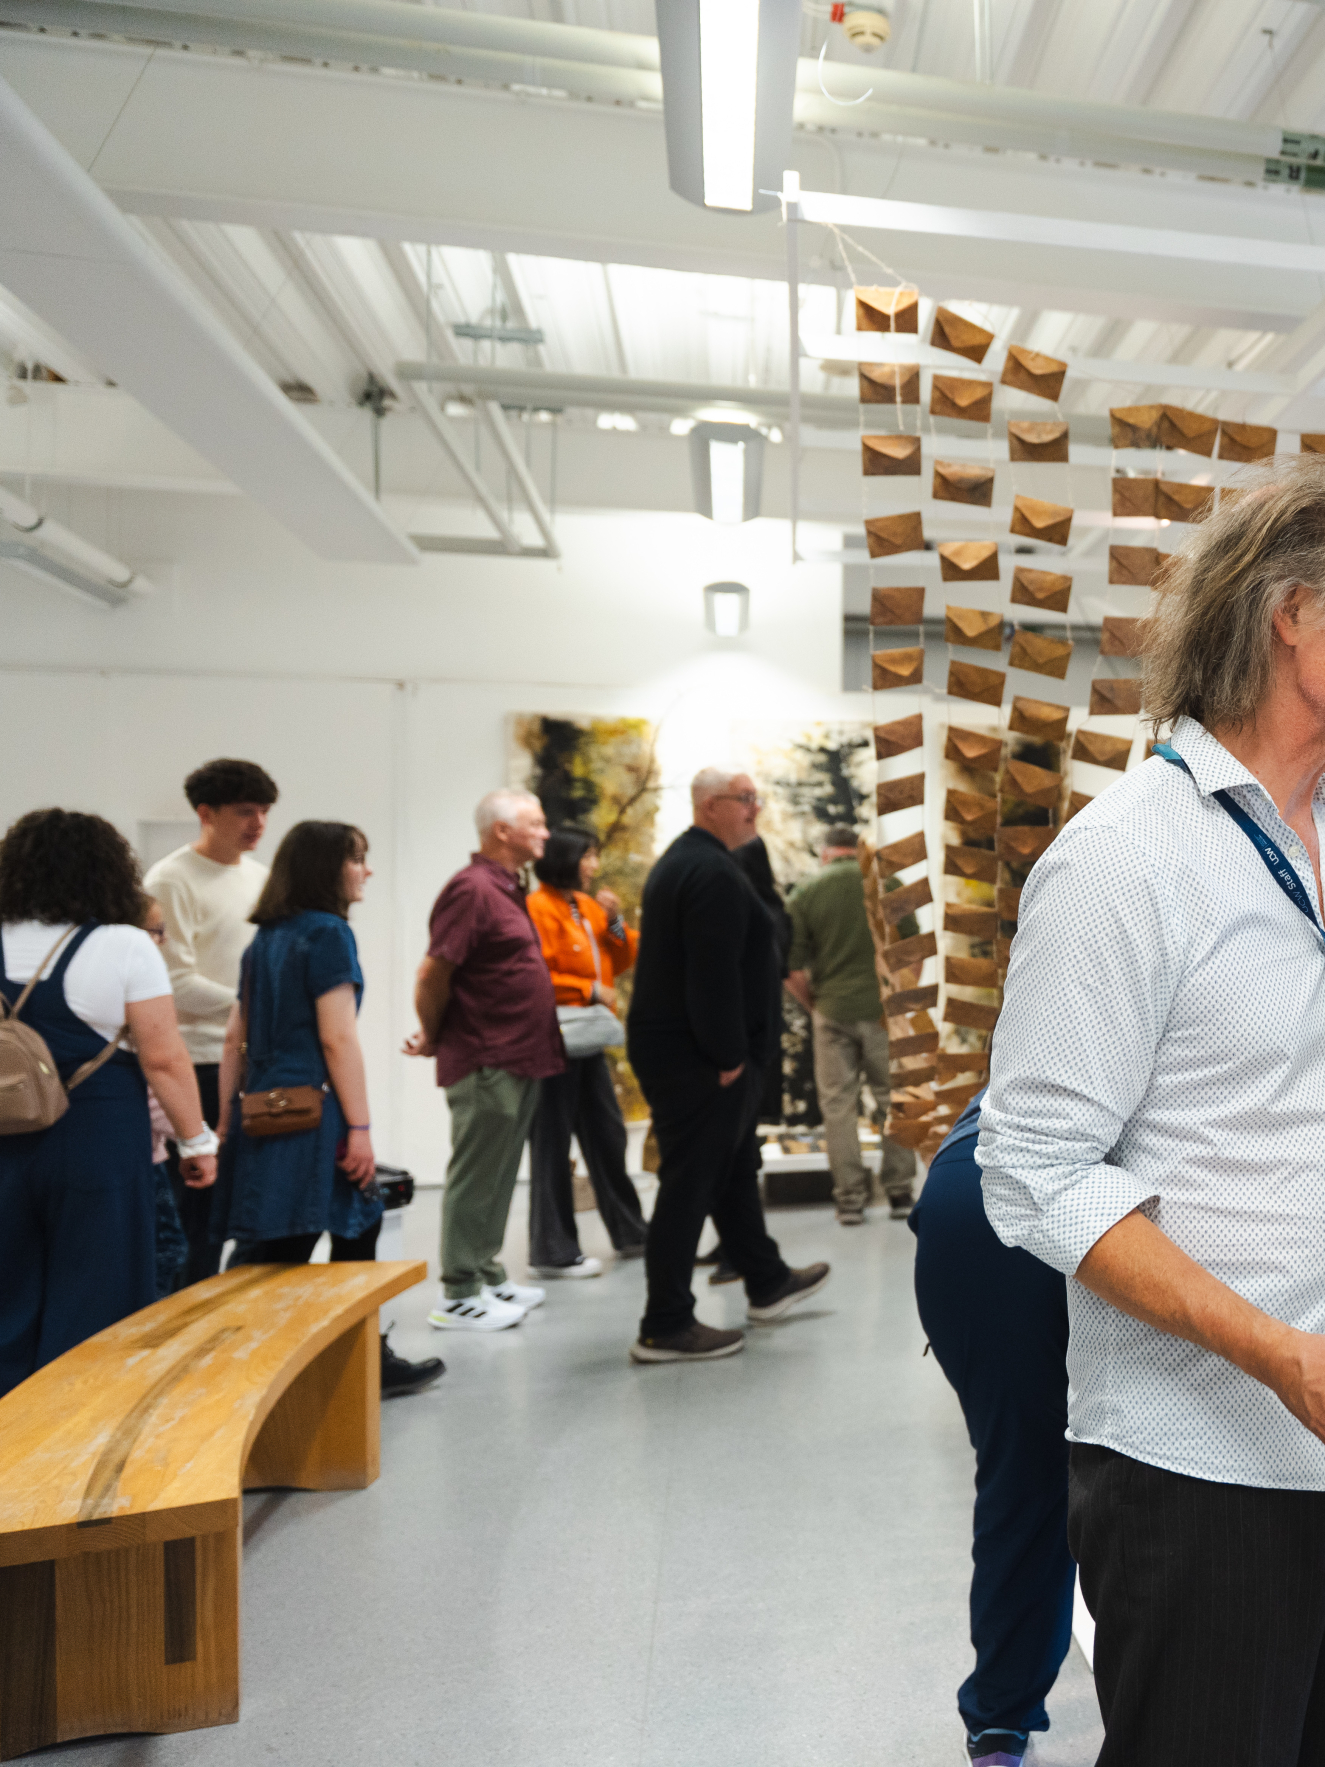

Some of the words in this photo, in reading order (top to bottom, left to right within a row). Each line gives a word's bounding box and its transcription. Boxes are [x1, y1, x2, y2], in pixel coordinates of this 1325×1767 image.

[1264, 847, 1280, 866] UCW
[1277, 868, 1297, 890] Staff
[1292, 891, 1309, 913] UCW
